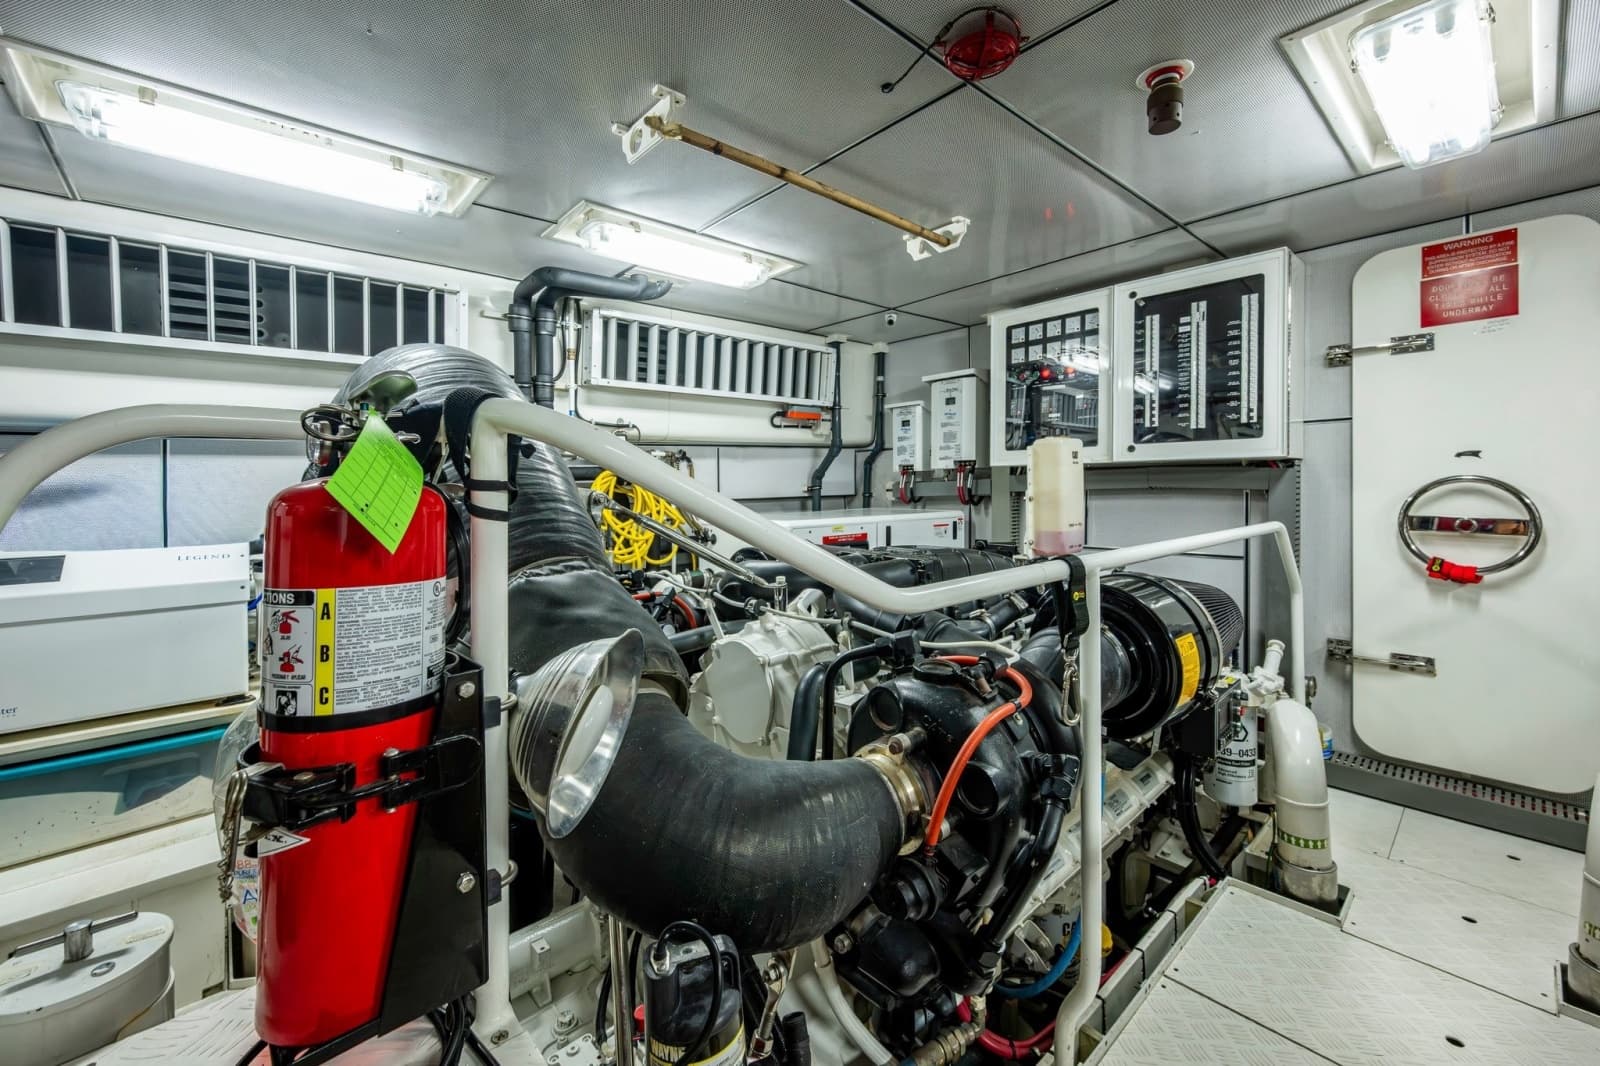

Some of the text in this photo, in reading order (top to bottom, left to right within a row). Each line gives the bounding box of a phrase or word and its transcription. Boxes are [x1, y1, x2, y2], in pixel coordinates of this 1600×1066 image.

[1443, 235, 1493, 250] WARNING
[1492, 273, 1504, 282] BE
[1488, 282, 1509, 292] ALL
[1442, 303, 1493, 318] UNDERWAY
[178, 553, 231, 561] LEGEND
[265, 591, 295, 604] TIONS
[320, 602, 331, 620] A
[320, 644, 330, 662] B
[319, 686, 329, 705] C
